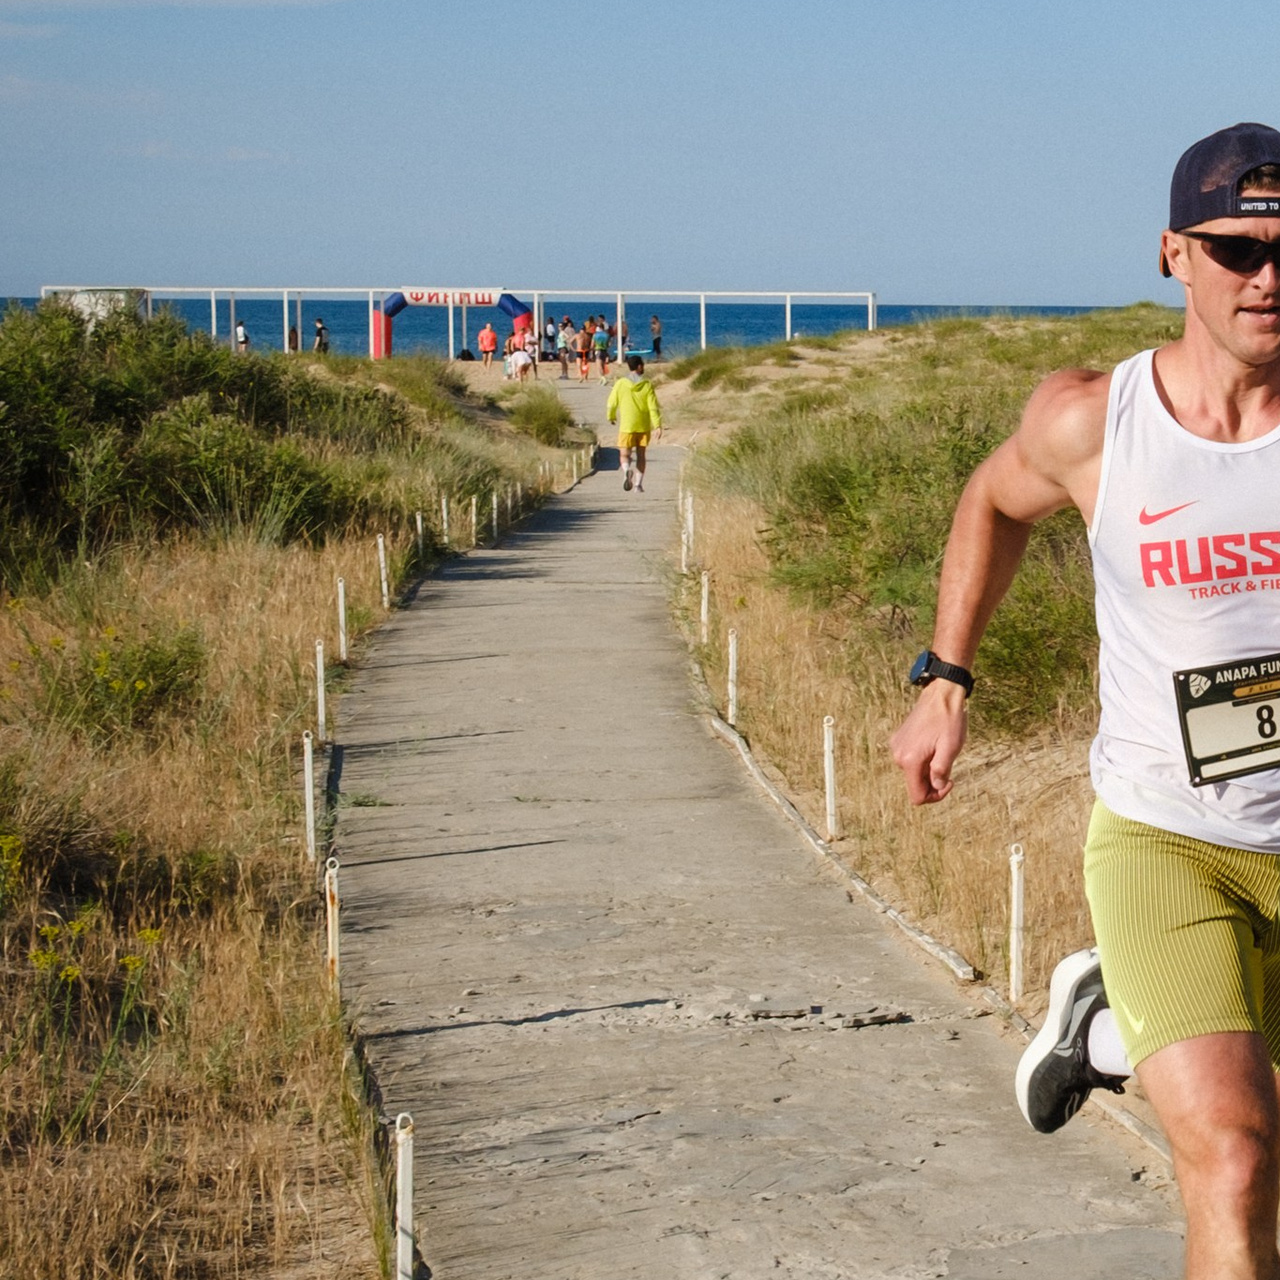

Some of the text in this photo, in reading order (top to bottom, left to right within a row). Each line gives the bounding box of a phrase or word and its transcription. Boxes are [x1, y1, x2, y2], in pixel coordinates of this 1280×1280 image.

[1240, 202, 1267, 211] UNITED
[1268, 202, 1279, 211] TO
[1188, 582, 1243, 600] TRACK
[1245, 580, 1257, 592] &
[1215, 665, 1258, 684] ANAPA
[1256, 704, 1277, 739] 8
